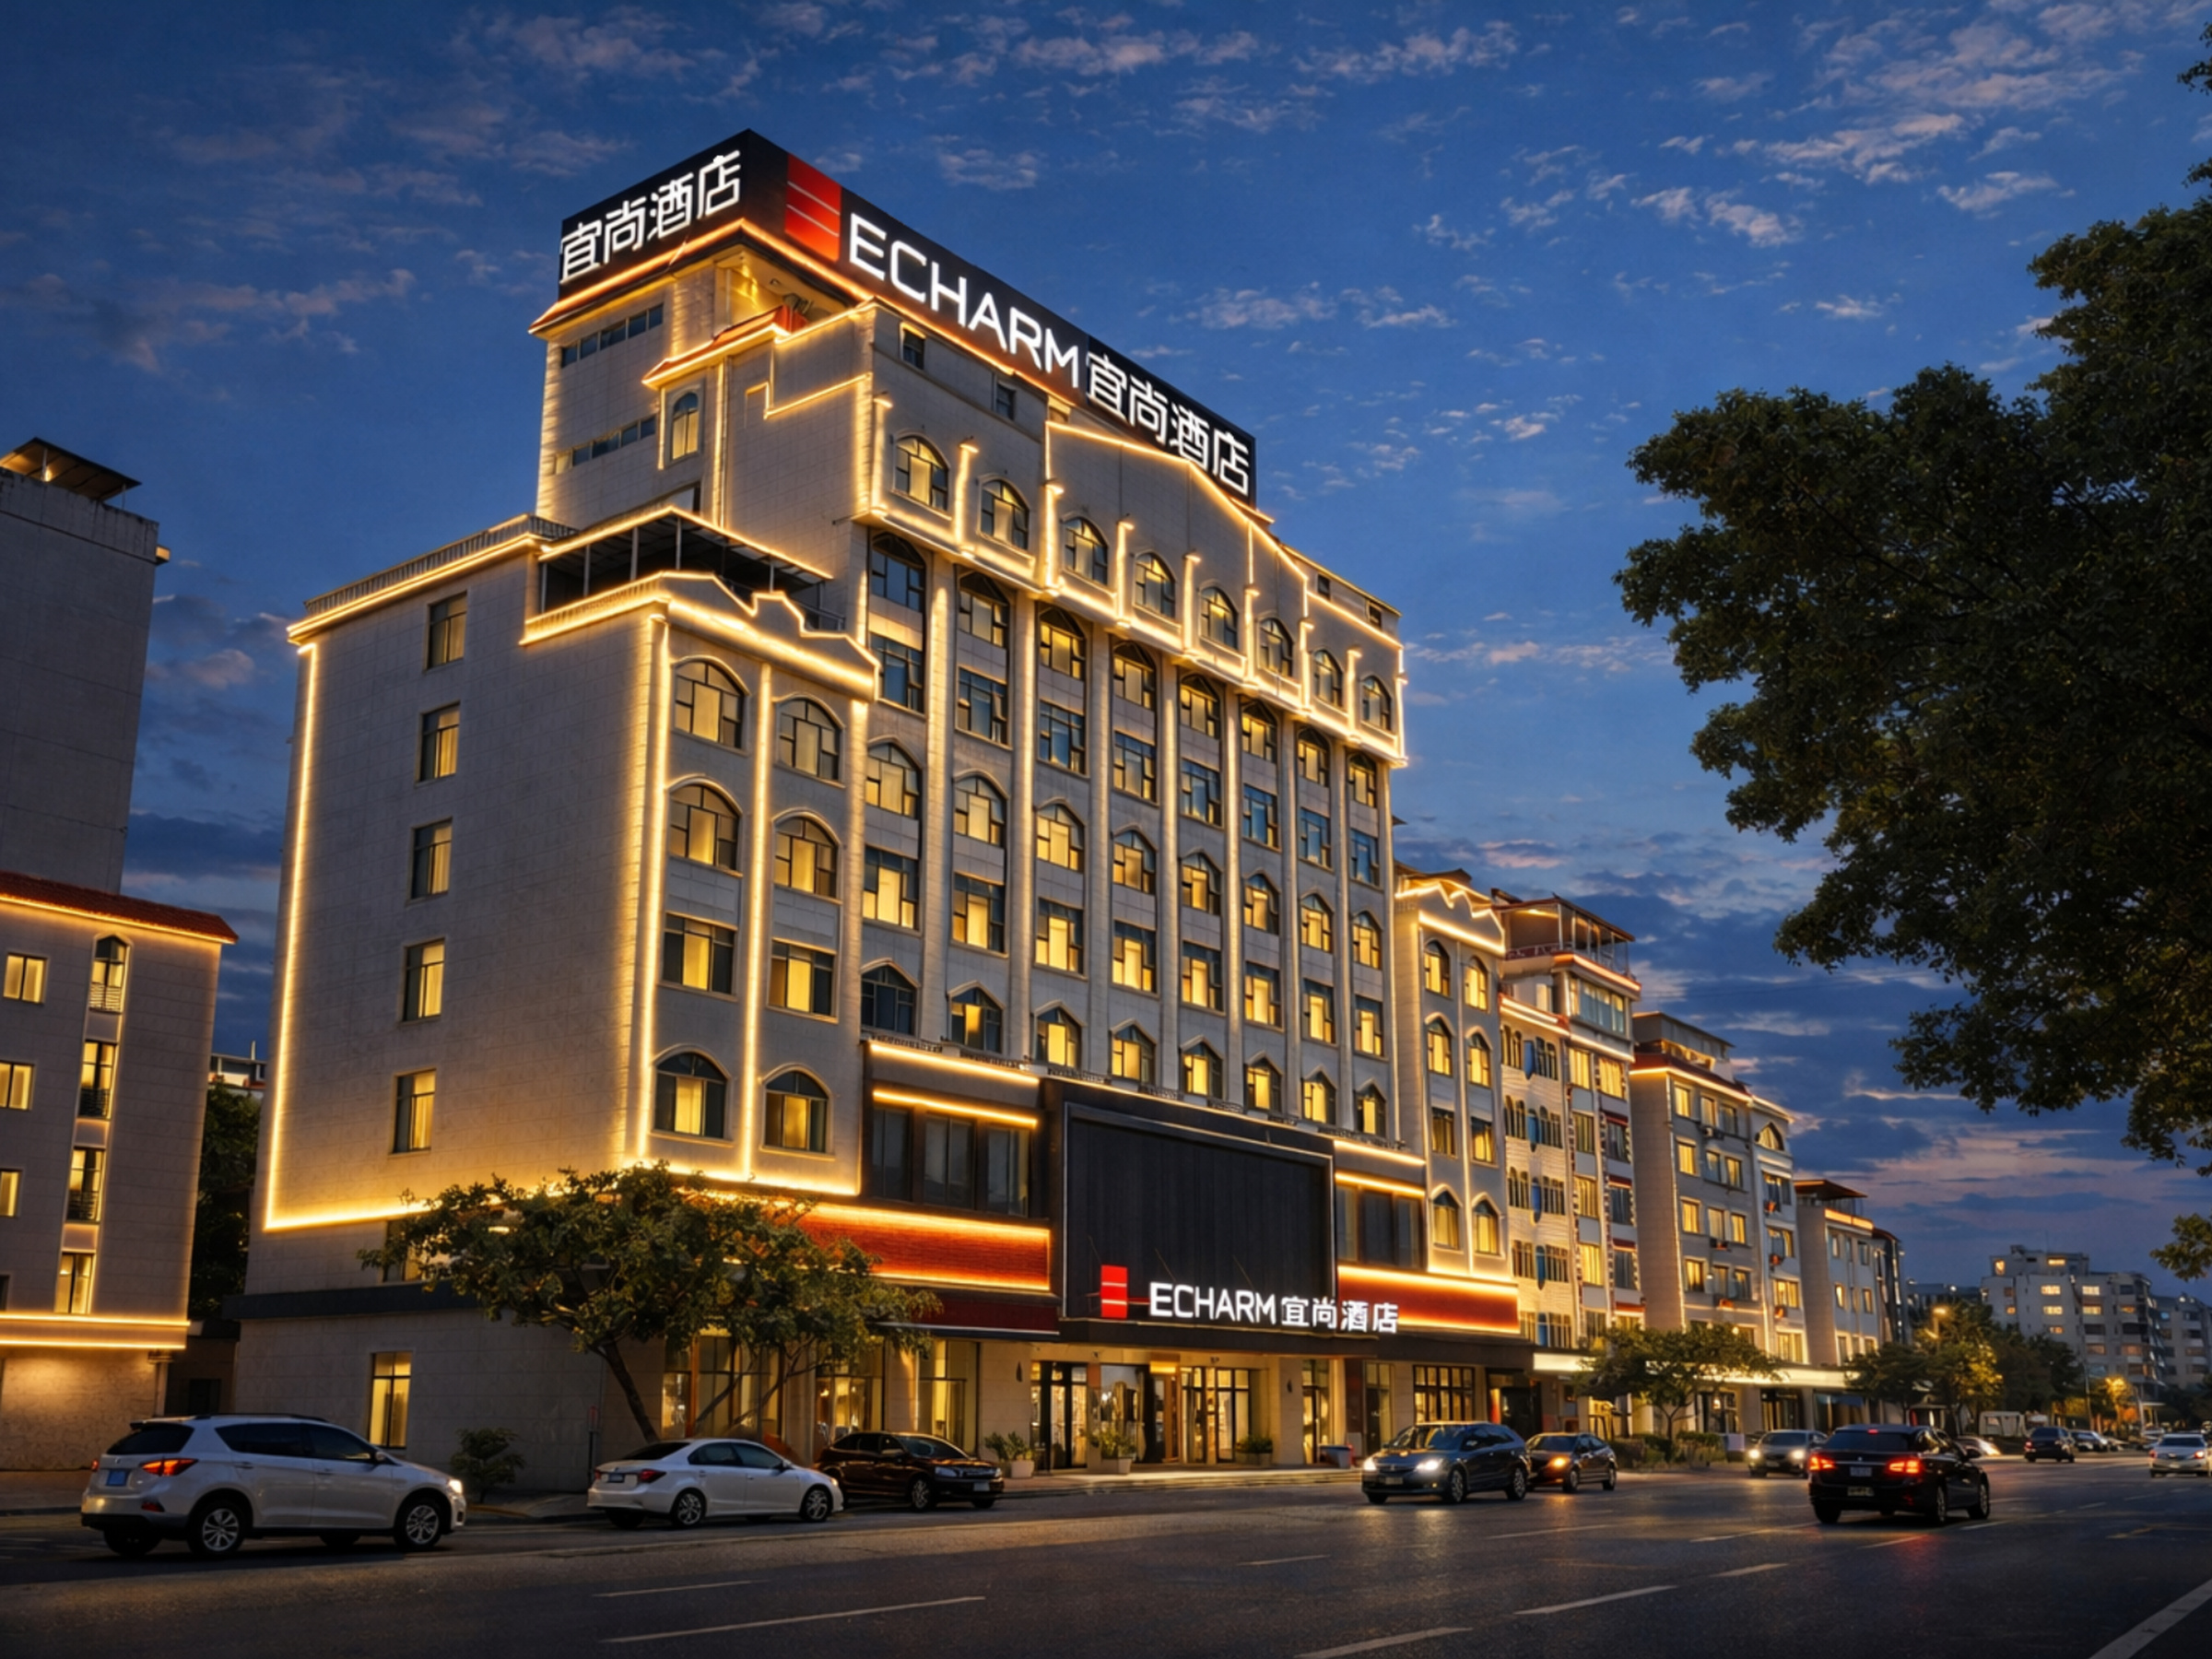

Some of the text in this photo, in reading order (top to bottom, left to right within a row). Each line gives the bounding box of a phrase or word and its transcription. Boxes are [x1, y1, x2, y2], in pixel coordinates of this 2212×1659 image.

[559, 150, 741, 284] 宜尚酒店
[849, 213, 1250, 495] ECHARM 宜尚酒店
[1150, 1282, 1398, 1333] ECHARM 宜尚酒店
